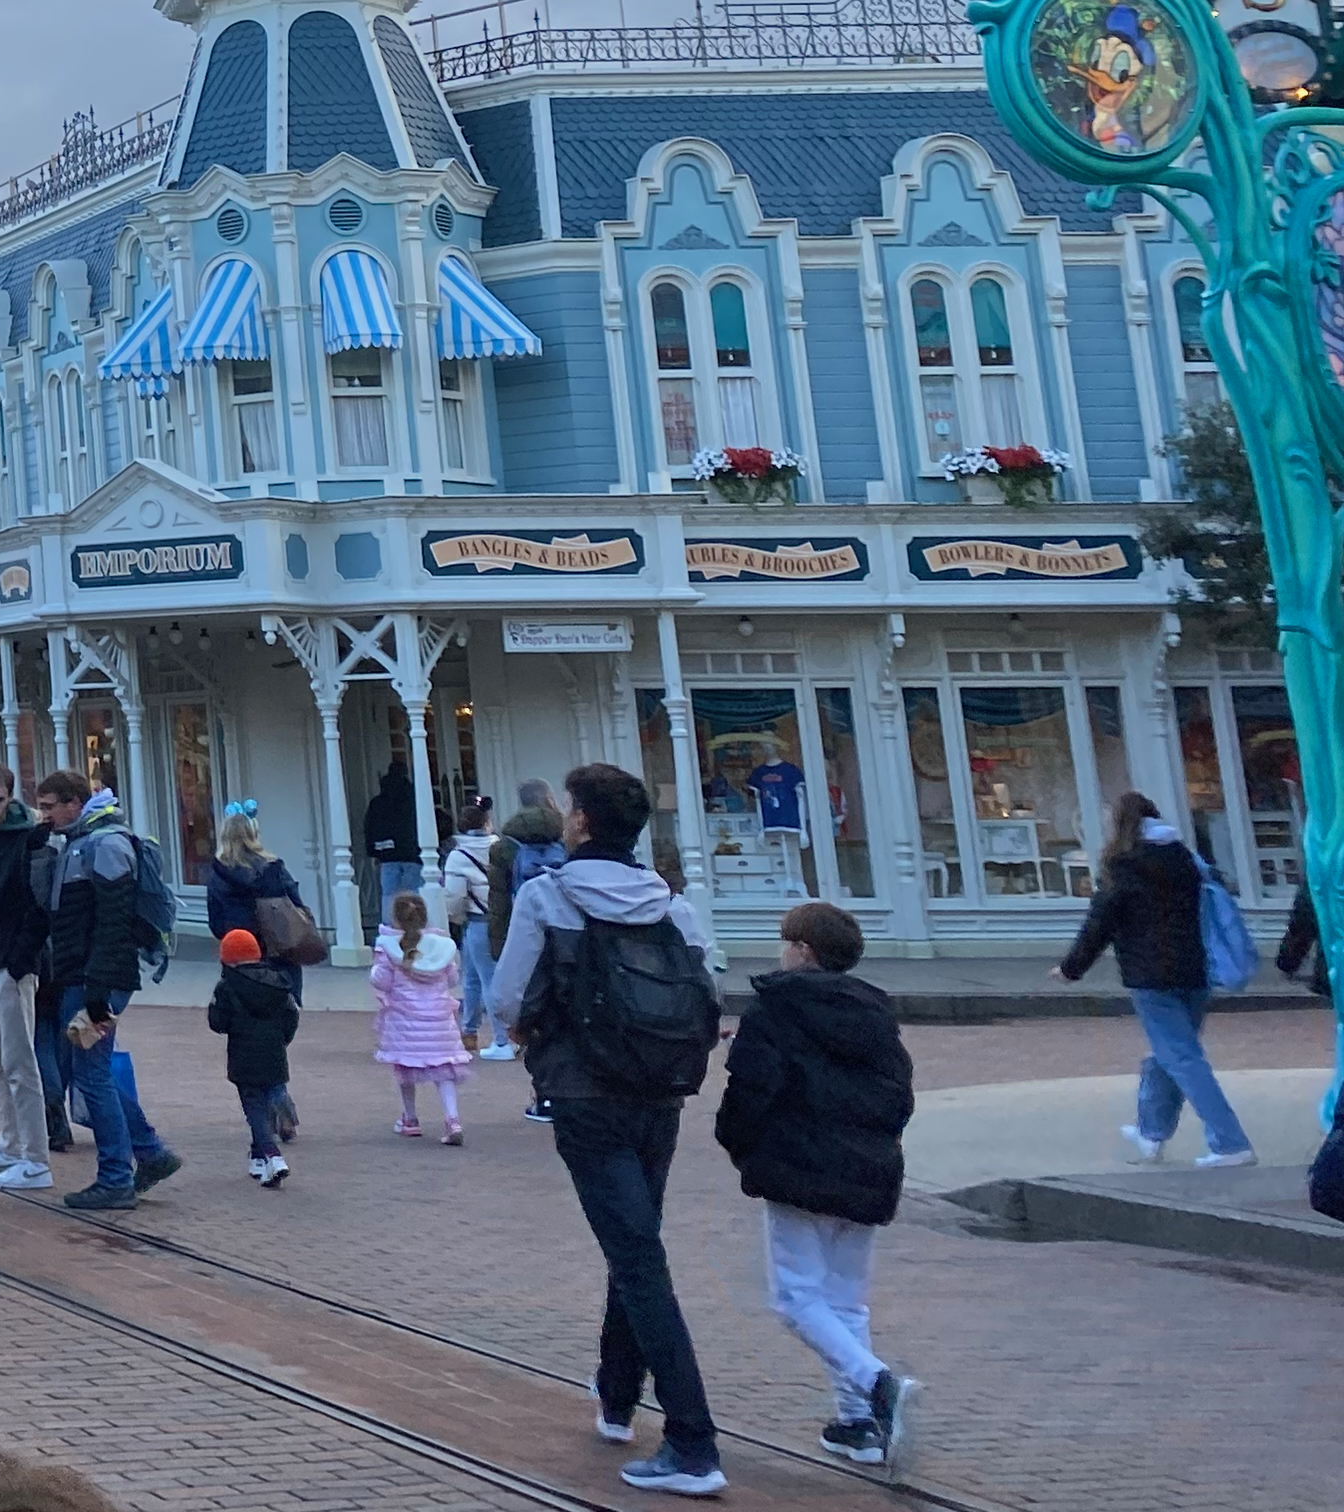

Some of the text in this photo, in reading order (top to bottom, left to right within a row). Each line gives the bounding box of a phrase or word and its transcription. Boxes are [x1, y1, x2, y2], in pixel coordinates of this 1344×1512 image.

[77, 542, 233, 579] EMPORIUM
[456, 539, 610, 567] BANGLES & BEADS
[744, 553, 755, 567] &
[762, 552, 850, 574] BROOCHES
[938, 544, 1112, 571] BOWLERS & BONNETS
